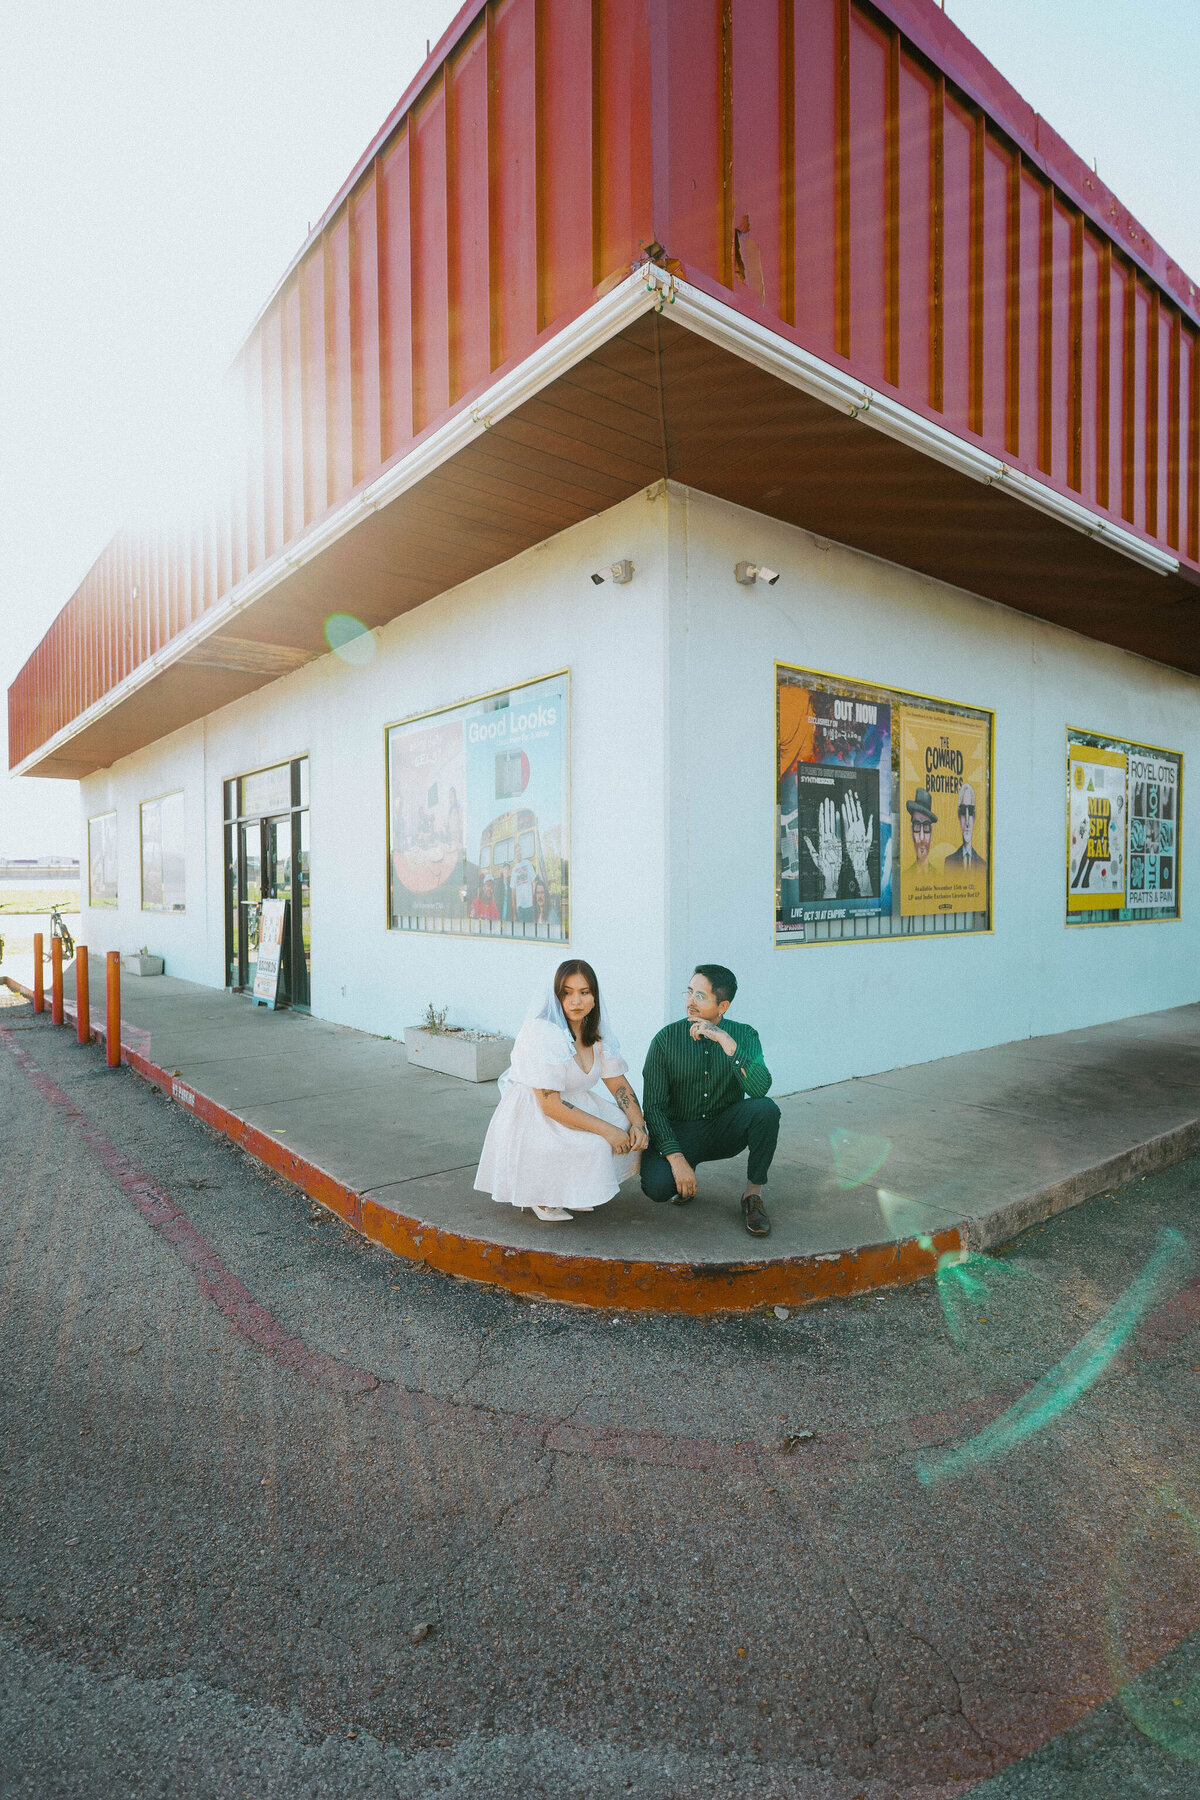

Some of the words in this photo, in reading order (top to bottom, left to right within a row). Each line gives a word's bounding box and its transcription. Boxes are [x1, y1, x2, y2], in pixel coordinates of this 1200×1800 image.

[834, 700, 853, 721] OUT
[855, 703, 878, 725] NOW
[469, 714, 506, 743] Good
[510, 706, 557, 734] Looks
[940, 736, 949, 748] THE
[925, 746, 963, 775] COWARD
[1131, 761, 1157, 781] ROYEL
[1158, 765, 1175, 784] OTIS
[926, 774, 963, 794] BROTHERS
[1087, 796, 1110, 816] MID
[1089, 818, 1108, 837] SPI
[1087, 838, 1110, 858] RAL
[1130, 892, 1153, 903] PRATTS
[1154, 892, 1158, 902] &
[1160, 891, 1173, 902] PAIN
[790, 908, 803, 918] LIVE
[803, 911, 815, 921] OCT
[815, 910, 820, 919] 31
[820, 910, 827, 919] AT
[827, 908, 846, 919] EMPIRE
